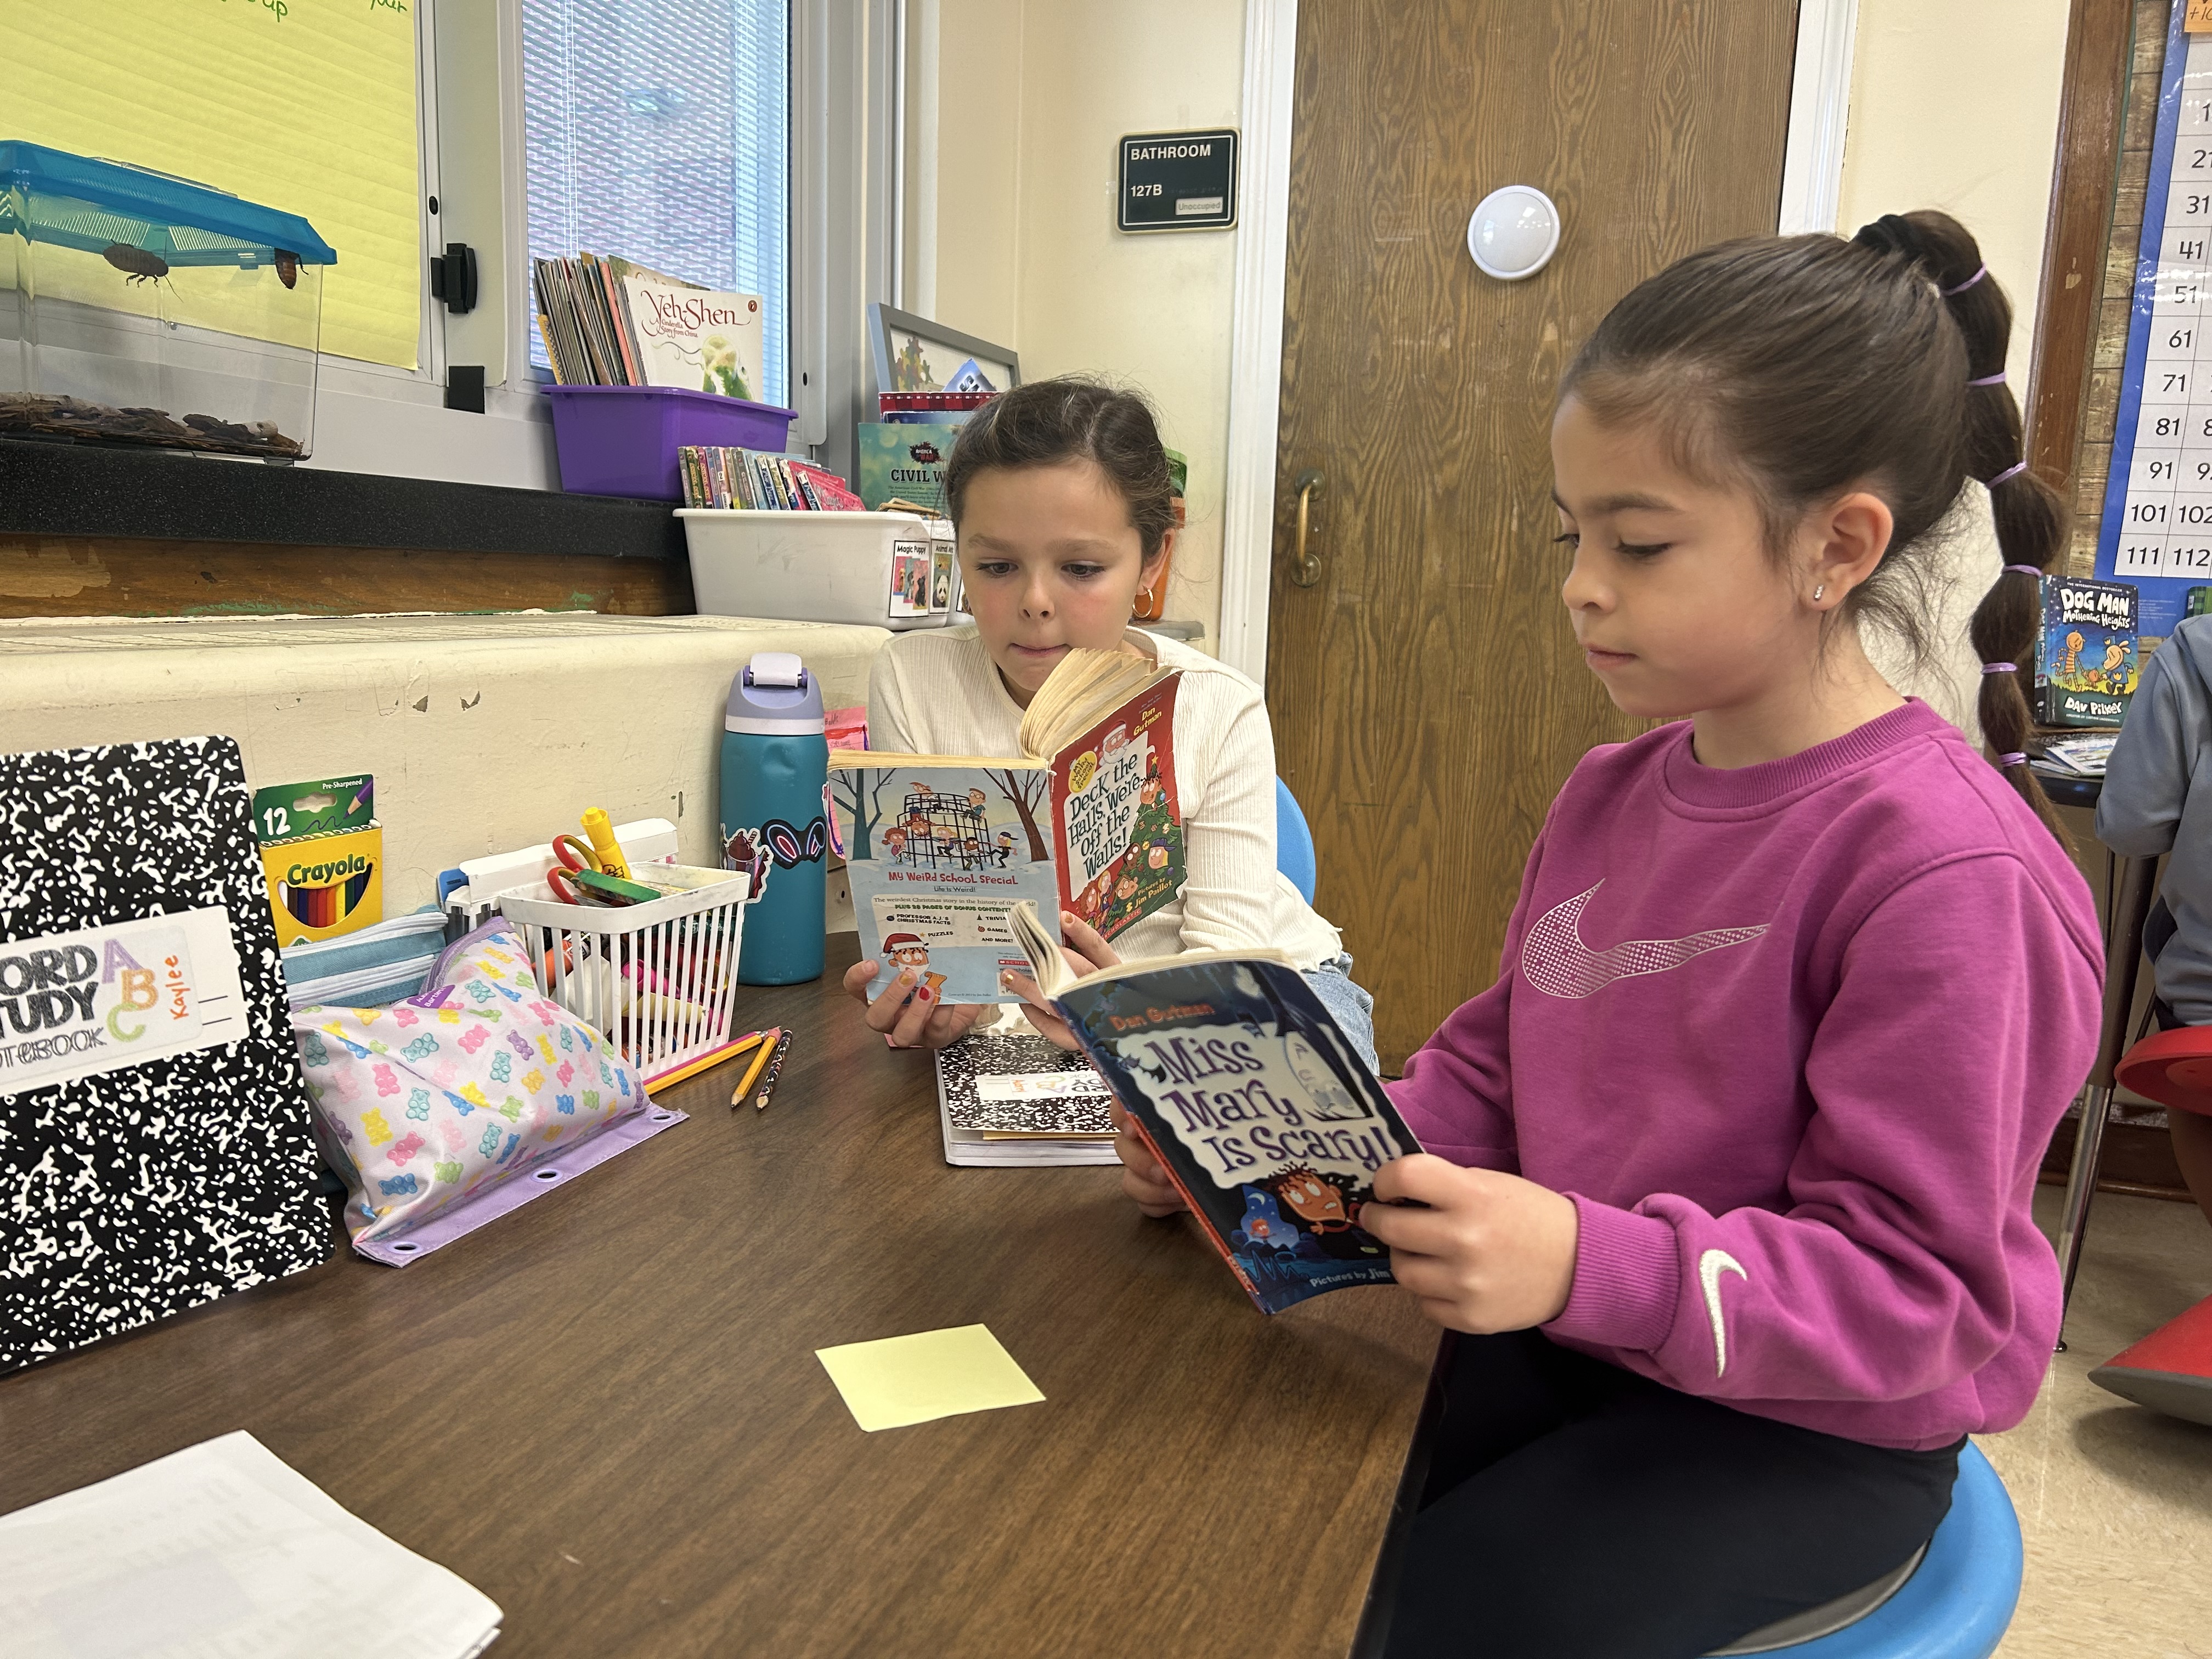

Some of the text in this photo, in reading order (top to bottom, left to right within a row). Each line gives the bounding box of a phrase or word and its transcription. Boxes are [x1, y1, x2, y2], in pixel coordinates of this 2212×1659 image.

[2203, 103, 2211, 122] 1
[1131, 144, 1211, 160] BATHROOM
[1130, 184, 1163, 197] 127B
[1178, 201, 1221, 211] Unoccupied
[2186, 195, 2210, 214] 31
[2179, 241, 2203, 259] 41
[2174, 285, 2198, 304] 51
[640, 290, 752, 337] Yeh-Shen
[2169, 330, 2191, 348] 61
[2163, 374, 2185, 392] 71
[2155, 418, 2212, 437] 81 8
[890, 469, 930, 483] CIVIL
[2149, 461, 2212, 480] 91 9
[2131, 505, 2166, 522] 101
[897, 545, 927, 555] Magic Puppy
[2127, 548, 2211, 567] 111 112
[2060, 588, 2094, 612] DOG
[2097, 592, 2130, 616] MAN
[1142, 707, 1155, 721] Dan
[2064, 696, 2088, 713] DAV
[1133, 711, 1162, 736] Gutman
[1113, 753, 1138, 783] the
[323, 778, 363, 789] Pre-Sharpened
[1068, 772, 1141, 849] Halls, We're
[263, 806, 291, 836] 12
[1081, 805, 1130, 857] Off the
[1083, 826, 1127, 880] Walls!
[287, 854, 365, 885] Crayola
[1135, 879, 1173, 909] Jim Paillot
[1104, 908, 1141, 939] SCHOLASTIC
[0, 945, 98, 996] ORD
[165, 955, 191, 1020] Kaylee
[0, 981, 99, 1039] TUDY
[1109, 1003, 1216, 1032] Dan Gutman
[1144, 1035, 1263, 1086] Miss
[1071, 1085, 1109, 1093] RD
[1161, 1078, 1302, 1133] Mary
[1201, 1125, 1395, 1173] Is Scary!
[1309, 1268, 1390, 1288] Pictures by Jim
